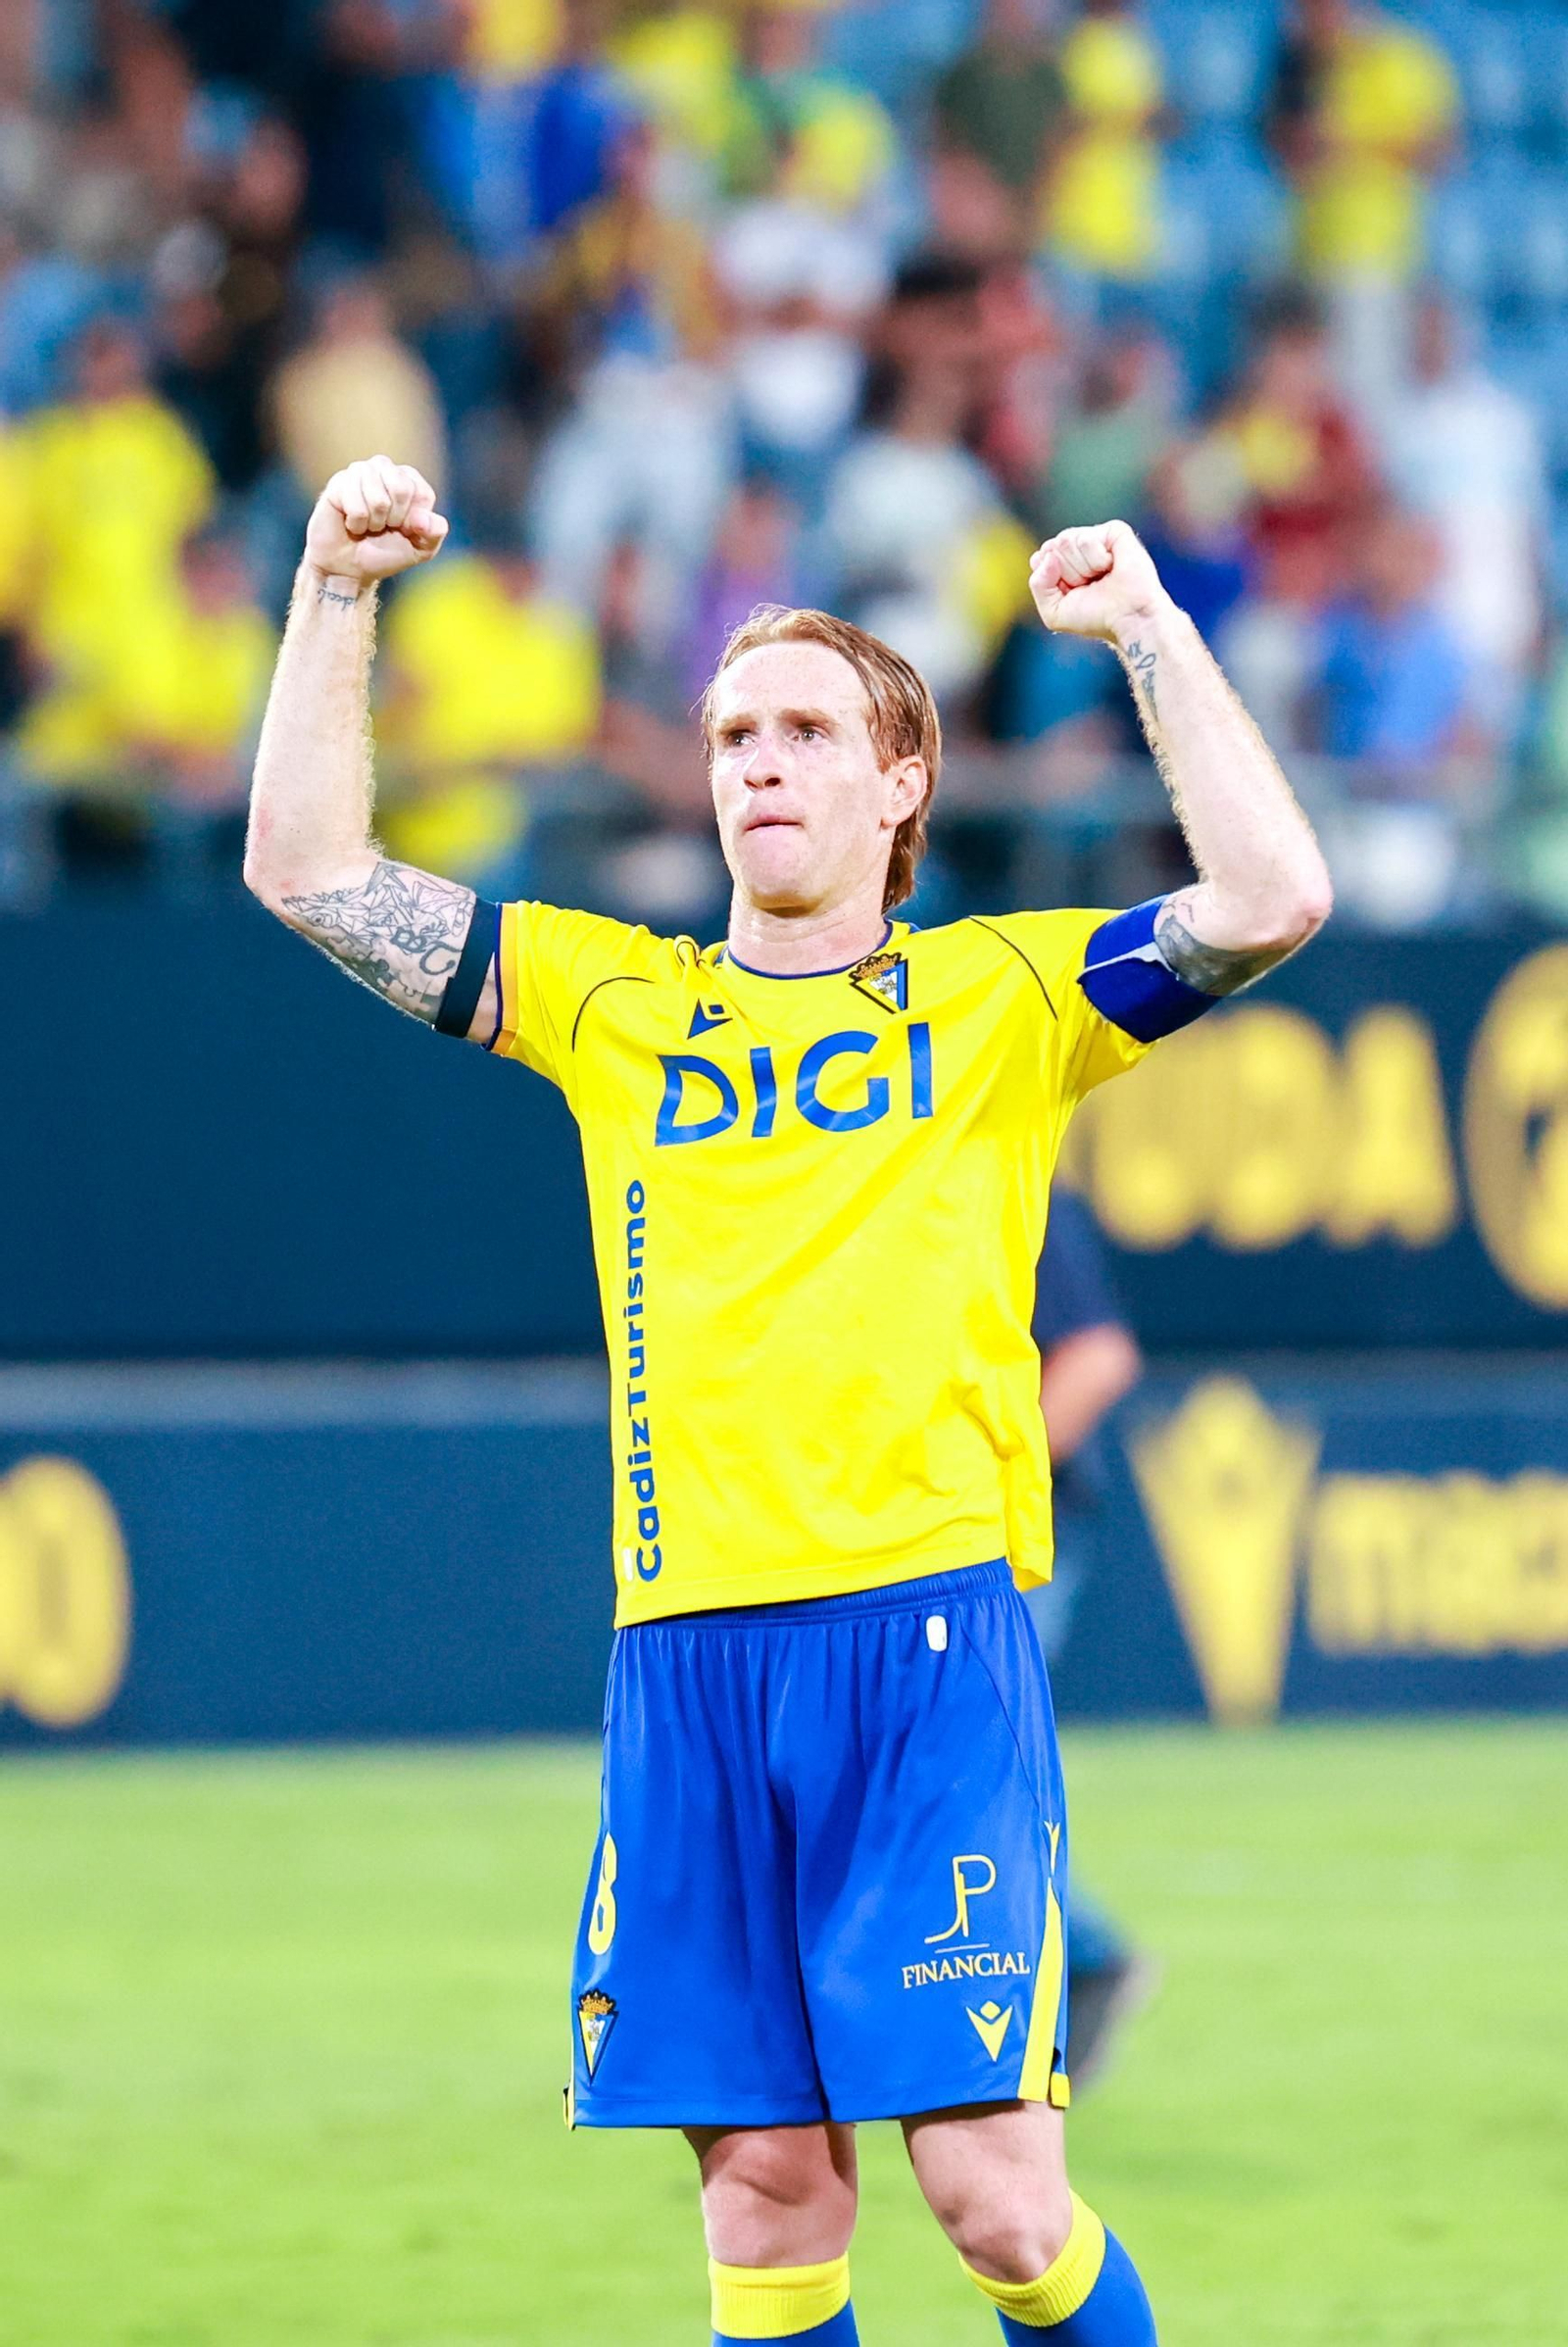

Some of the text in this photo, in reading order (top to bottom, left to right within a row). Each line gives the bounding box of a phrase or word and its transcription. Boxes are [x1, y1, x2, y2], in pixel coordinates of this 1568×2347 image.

[655, 1022, 934, 1147] DIGI
[588, 1831, 617, 1955] 8
[901, 1951, 1031, 1989] FINANCIAL
